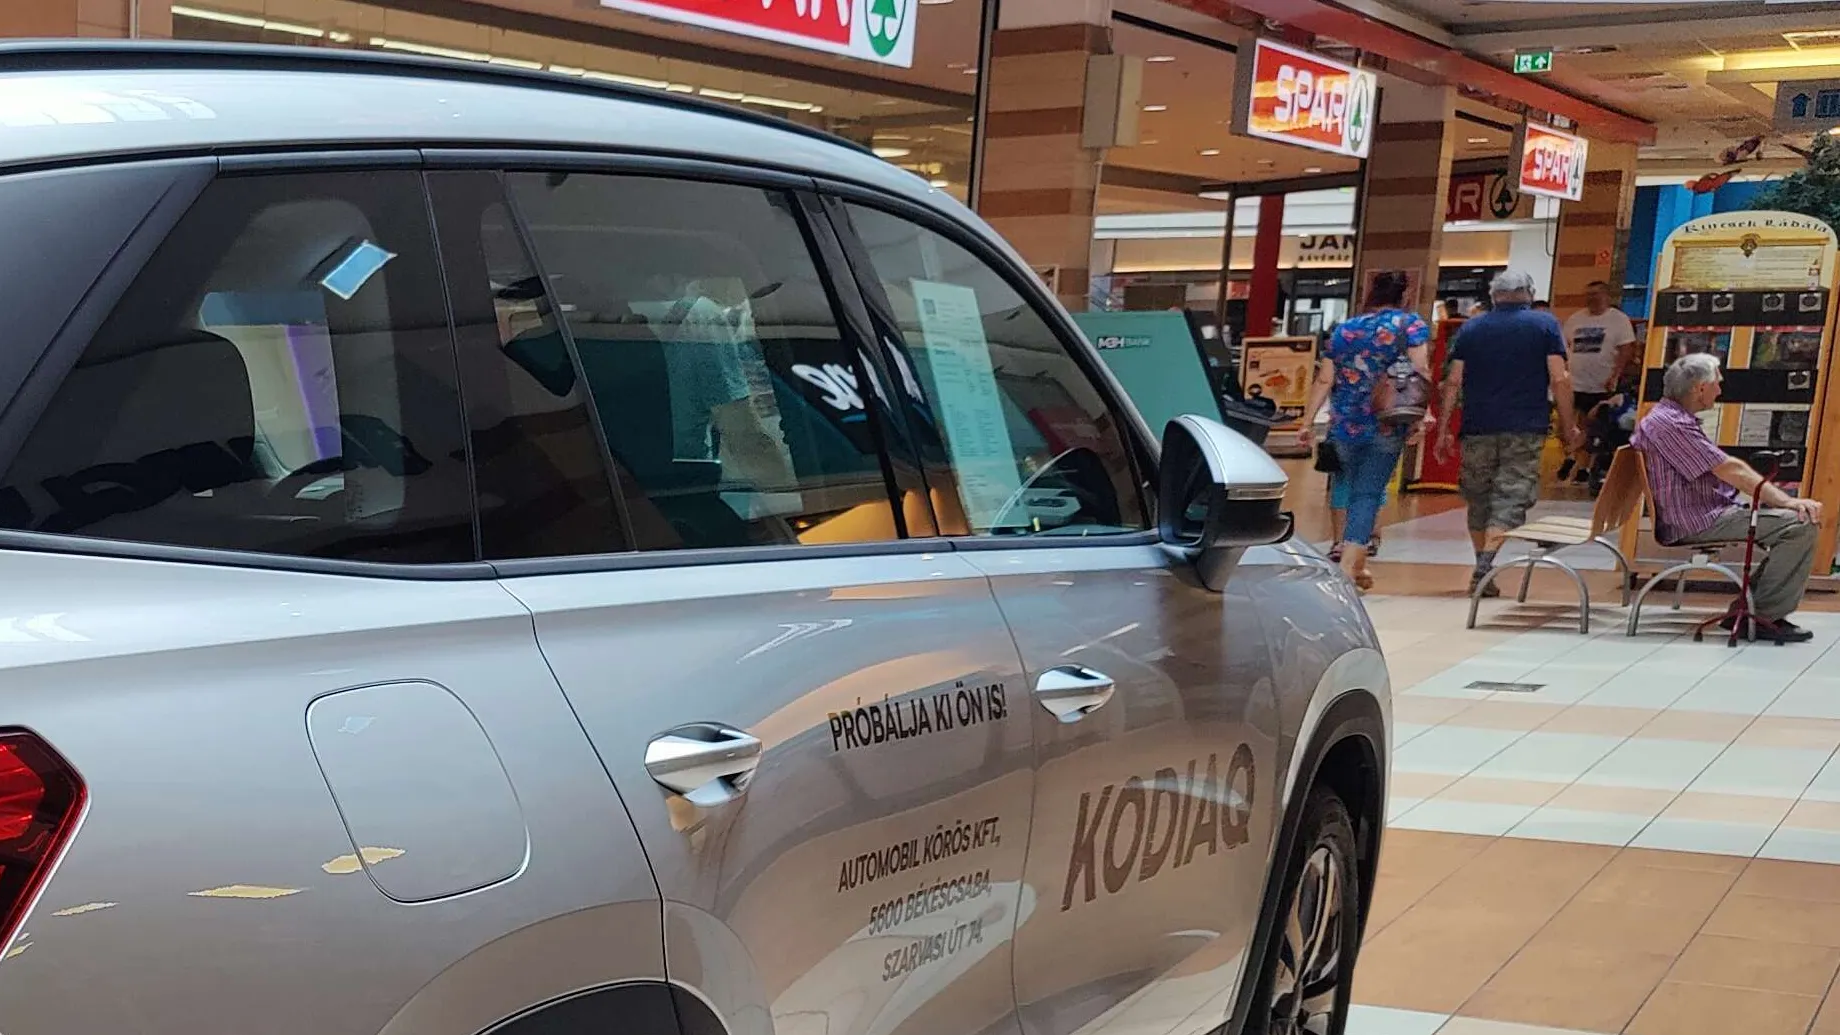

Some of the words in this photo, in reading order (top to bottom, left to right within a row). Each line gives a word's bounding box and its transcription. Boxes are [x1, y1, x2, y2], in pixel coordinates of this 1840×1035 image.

[1274, 64, 1347, 136] SPAR
[1533, 143, 1570, 185] SPAR
[827, 692, 932, 752] PRÓBÁLJA
[932, 694, 954, 732] KI
[956, 681, 984, 727] ÖN
[985, 683, 1008, 721] IS!
[1060, 742, 1255, 912] KODIAQ
[837, 838, 921, 893] AUTOMOBIL
[868, 896, 904, 936] 5600
